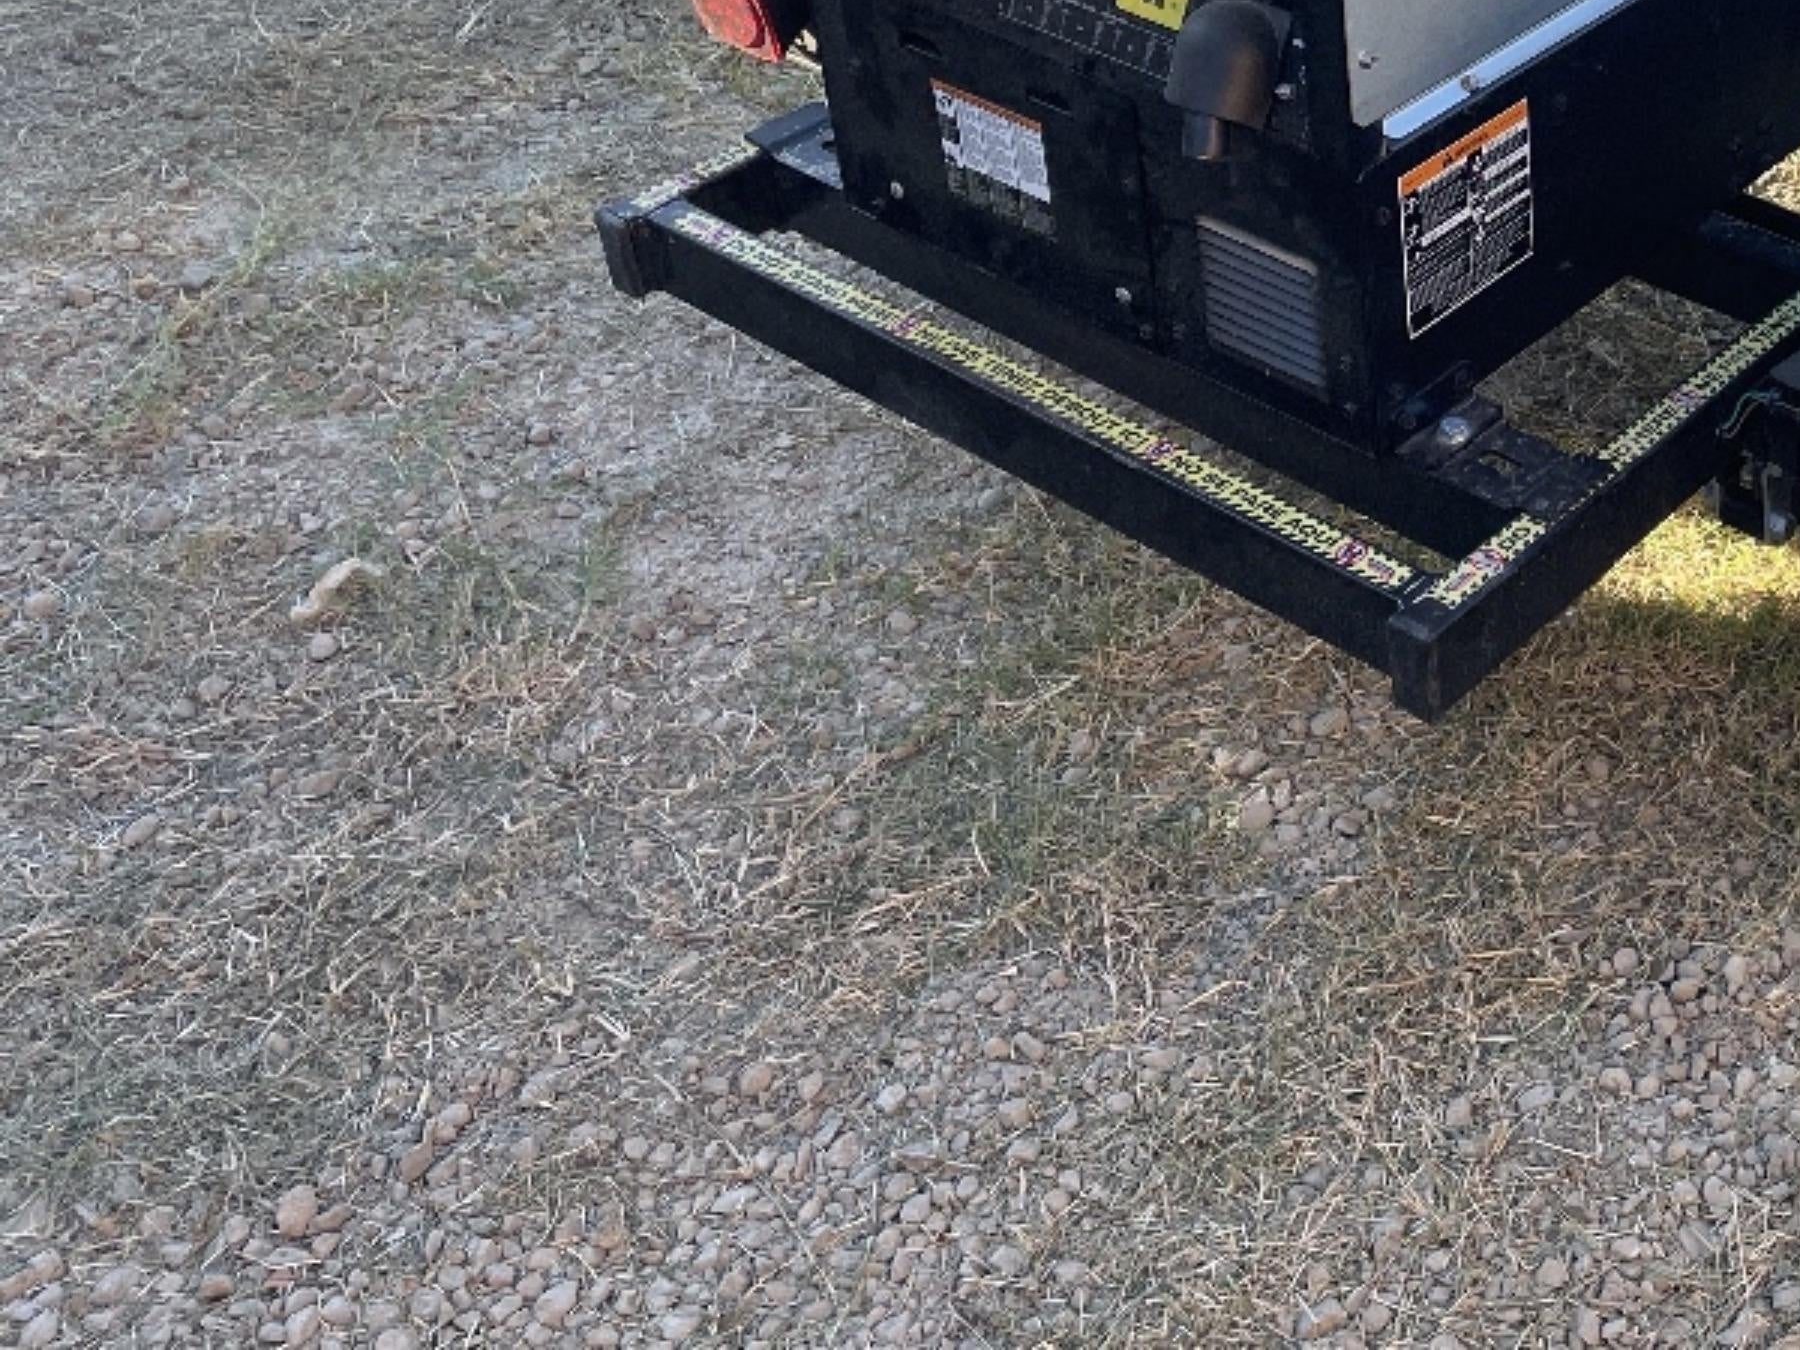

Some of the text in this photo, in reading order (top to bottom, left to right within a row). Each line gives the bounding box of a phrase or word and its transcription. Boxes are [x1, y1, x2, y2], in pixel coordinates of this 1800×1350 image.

[1172, 453, 1203, 475] NO
[1202, 470, 1234, 491] SE
[1232, 486, 1286, 519] PARE
